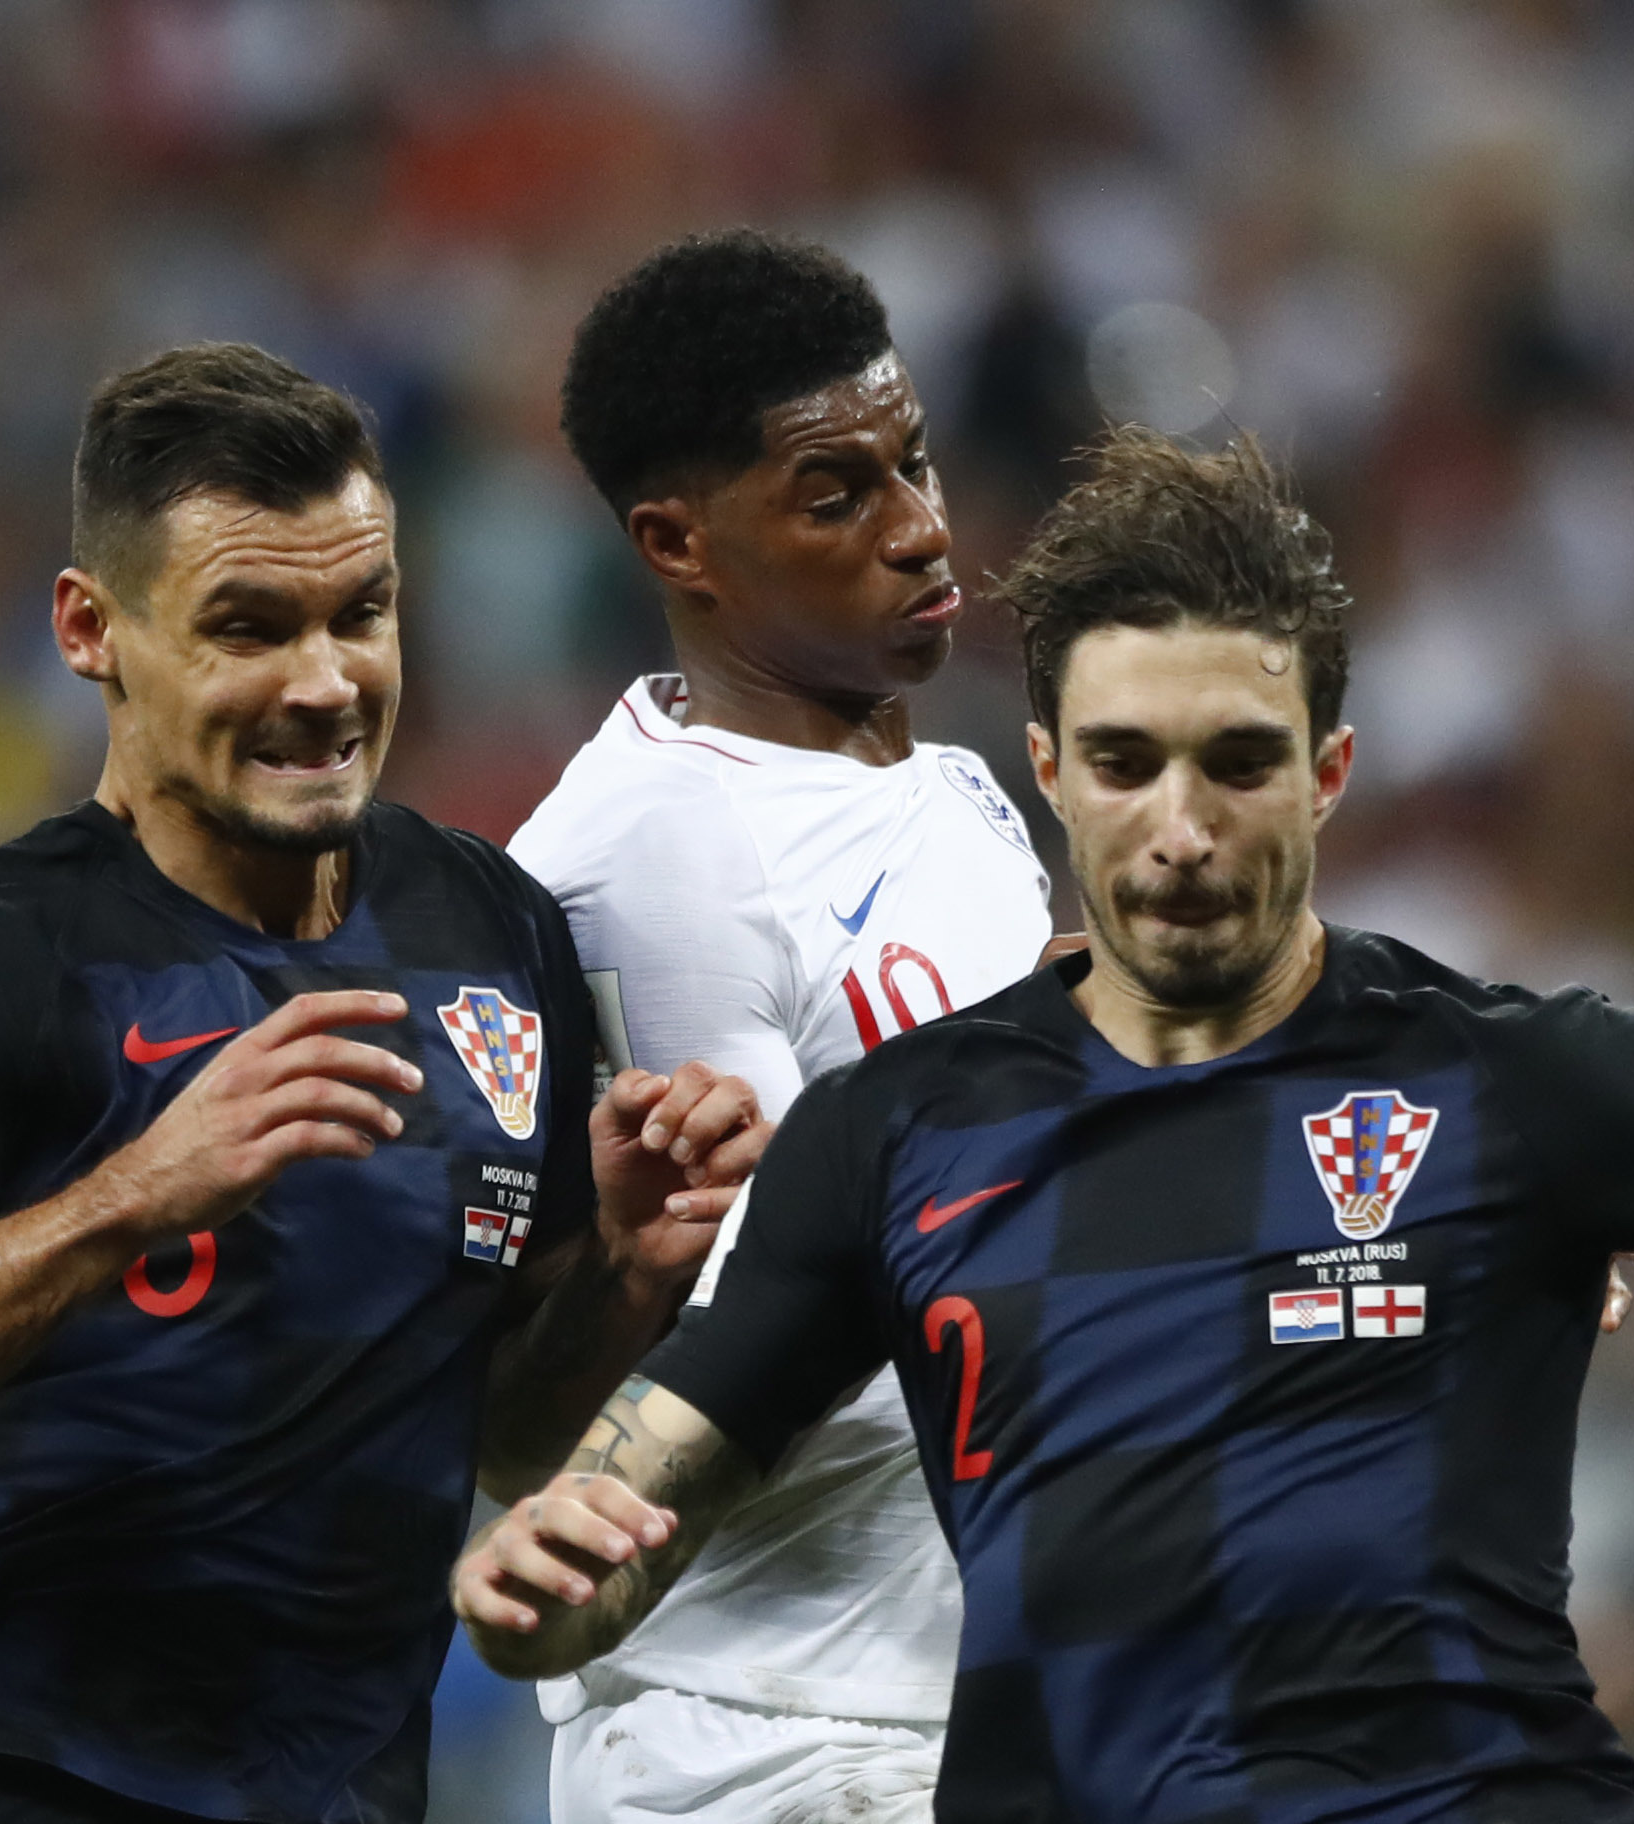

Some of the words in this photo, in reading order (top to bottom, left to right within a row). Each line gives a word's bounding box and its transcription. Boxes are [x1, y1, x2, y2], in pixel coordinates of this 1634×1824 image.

[481, 1164, 523, 1188] MOSKVA
[1363, 1243, 1407, 1262] (RUS)
[924, 1296, 994, 1481] 2
